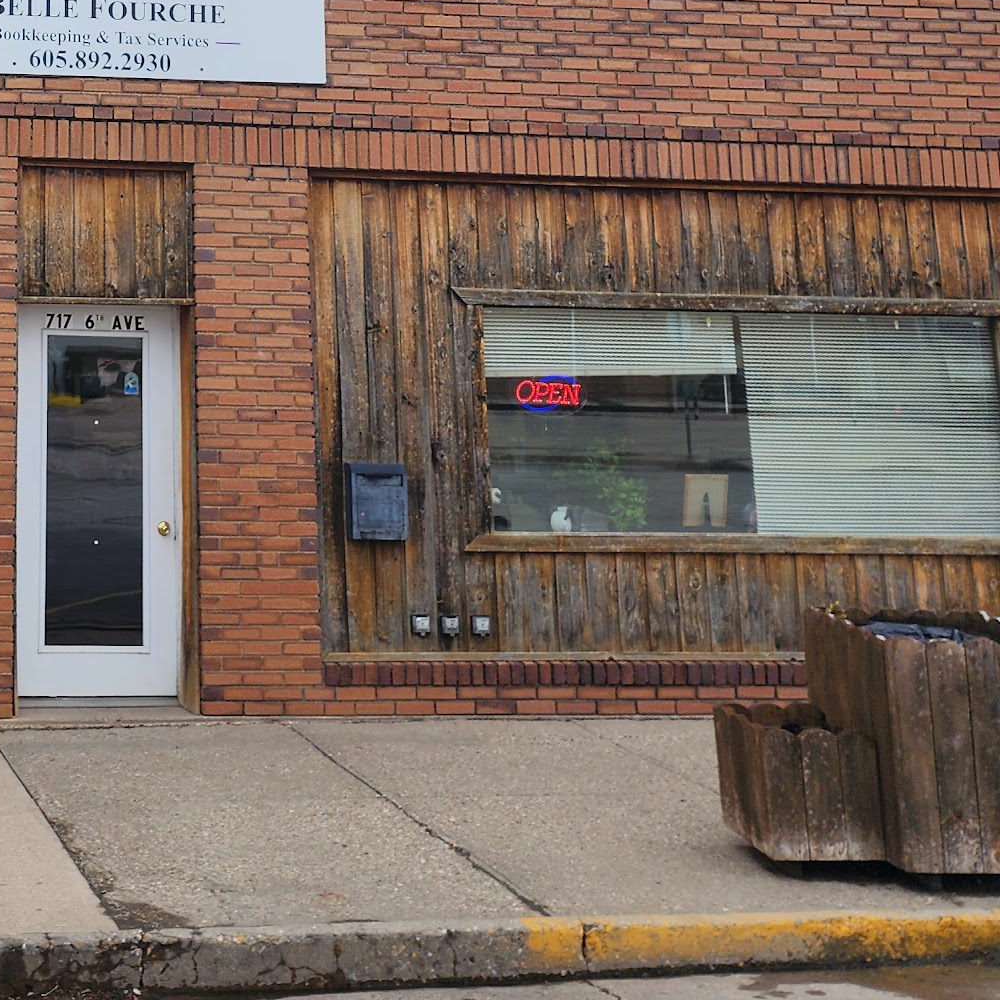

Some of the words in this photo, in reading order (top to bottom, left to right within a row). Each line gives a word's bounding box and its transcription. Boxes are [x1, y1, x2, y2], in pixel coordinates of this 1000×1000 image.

[96, 31, 109, 44] &
[114, 31, 142, 45] Tax
[147, 33, 209, 48] Services
[29, 50, 171, 72] 605.892.2930
[46, 313, 72, 328] 717
[112, 315, 144, 330] AVE
[516, 379, 581, 406] OPEN
